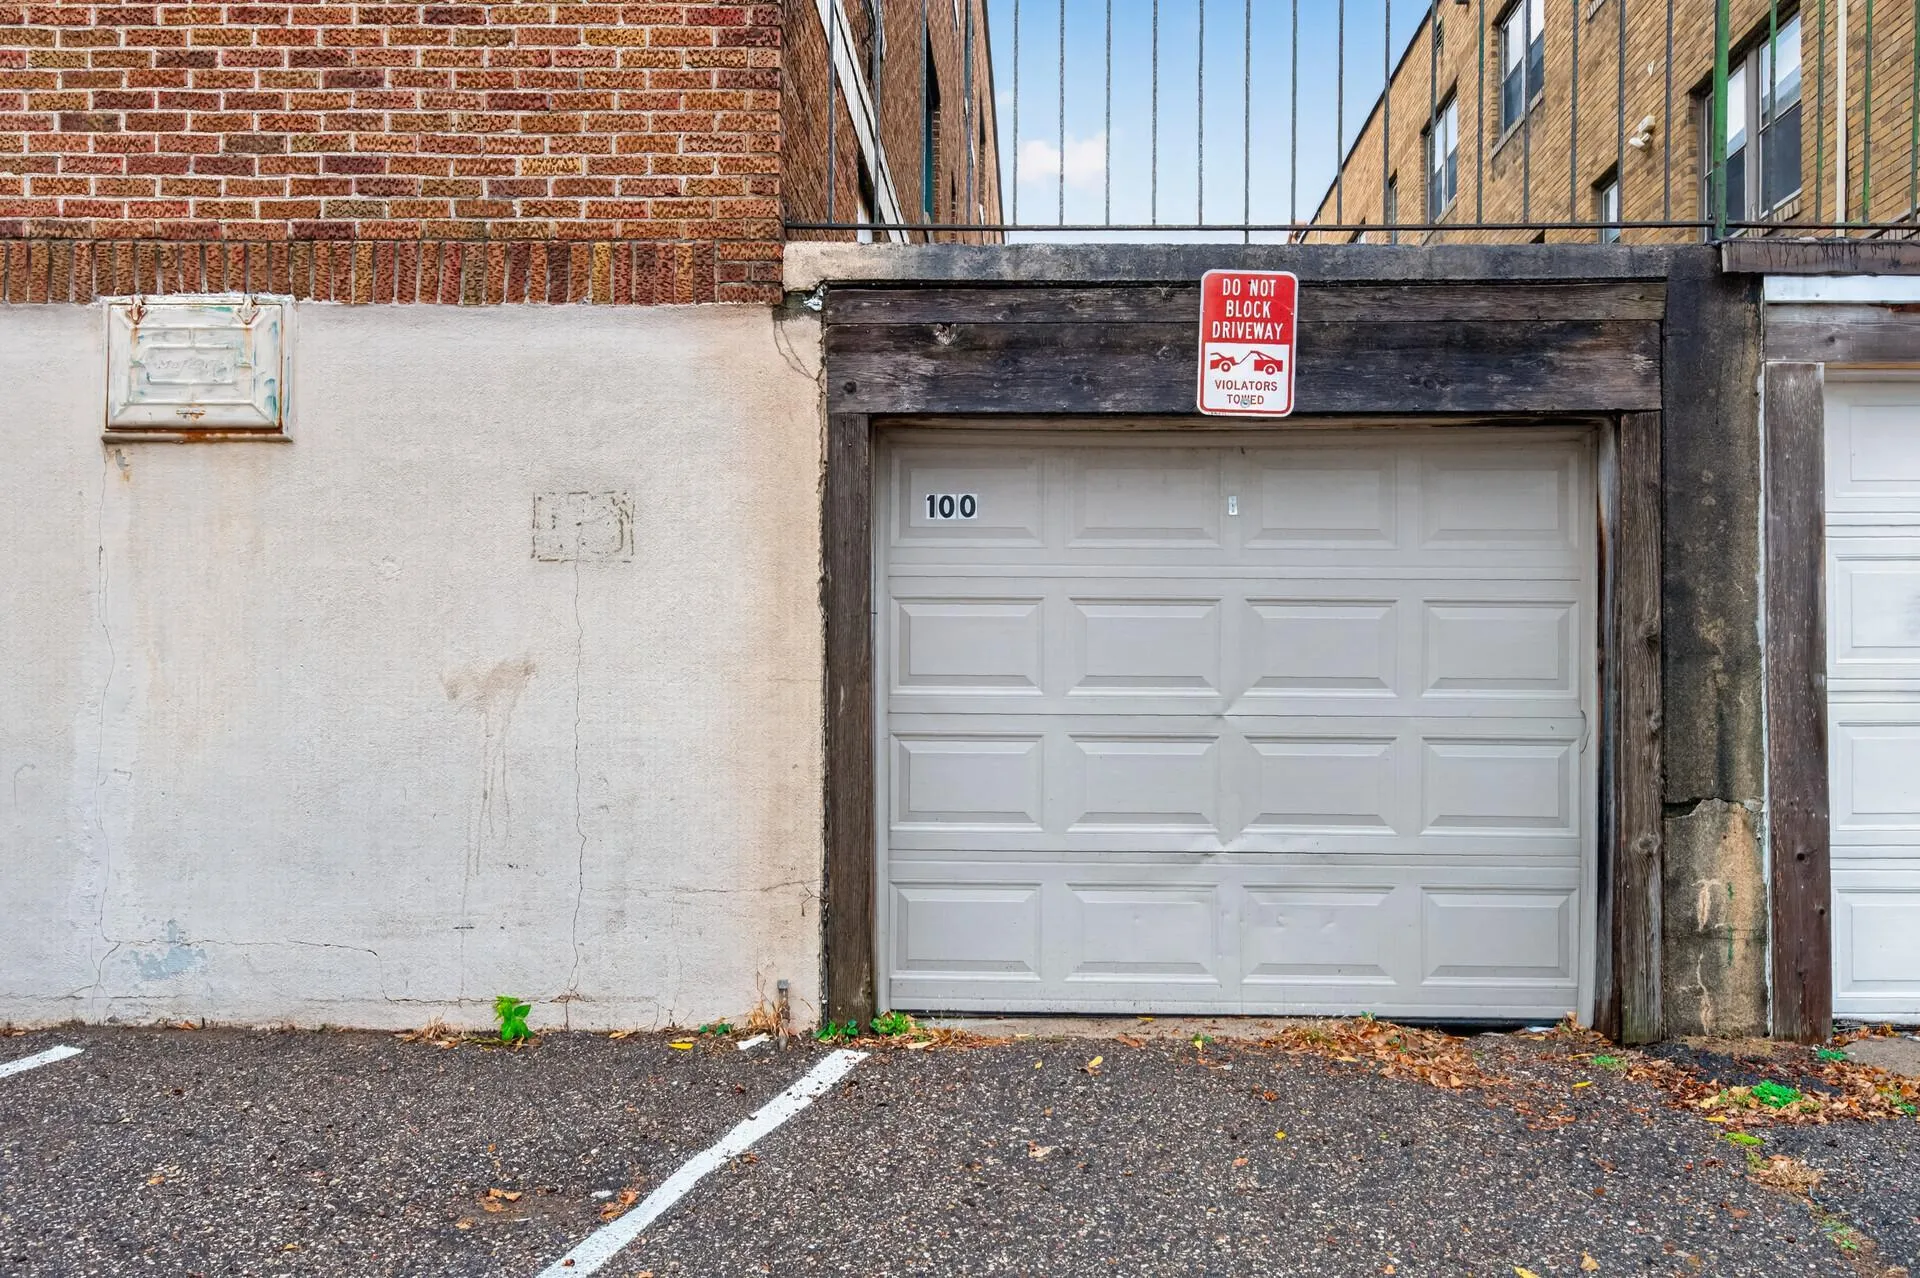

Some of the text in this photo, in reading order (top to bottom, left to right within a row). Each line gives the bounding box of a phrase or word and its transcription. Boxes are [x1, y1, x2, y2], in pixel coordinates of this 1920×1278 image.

[1222, 278, 1277, 297] DO NOT
[1225, 300, 1272, 319] BLOCK
[1212, 321, 1284, 340] DRIVEWAY
[1214, 379, 1278, 392] VIOLATORS
[926, 494, 976, 518] 100
